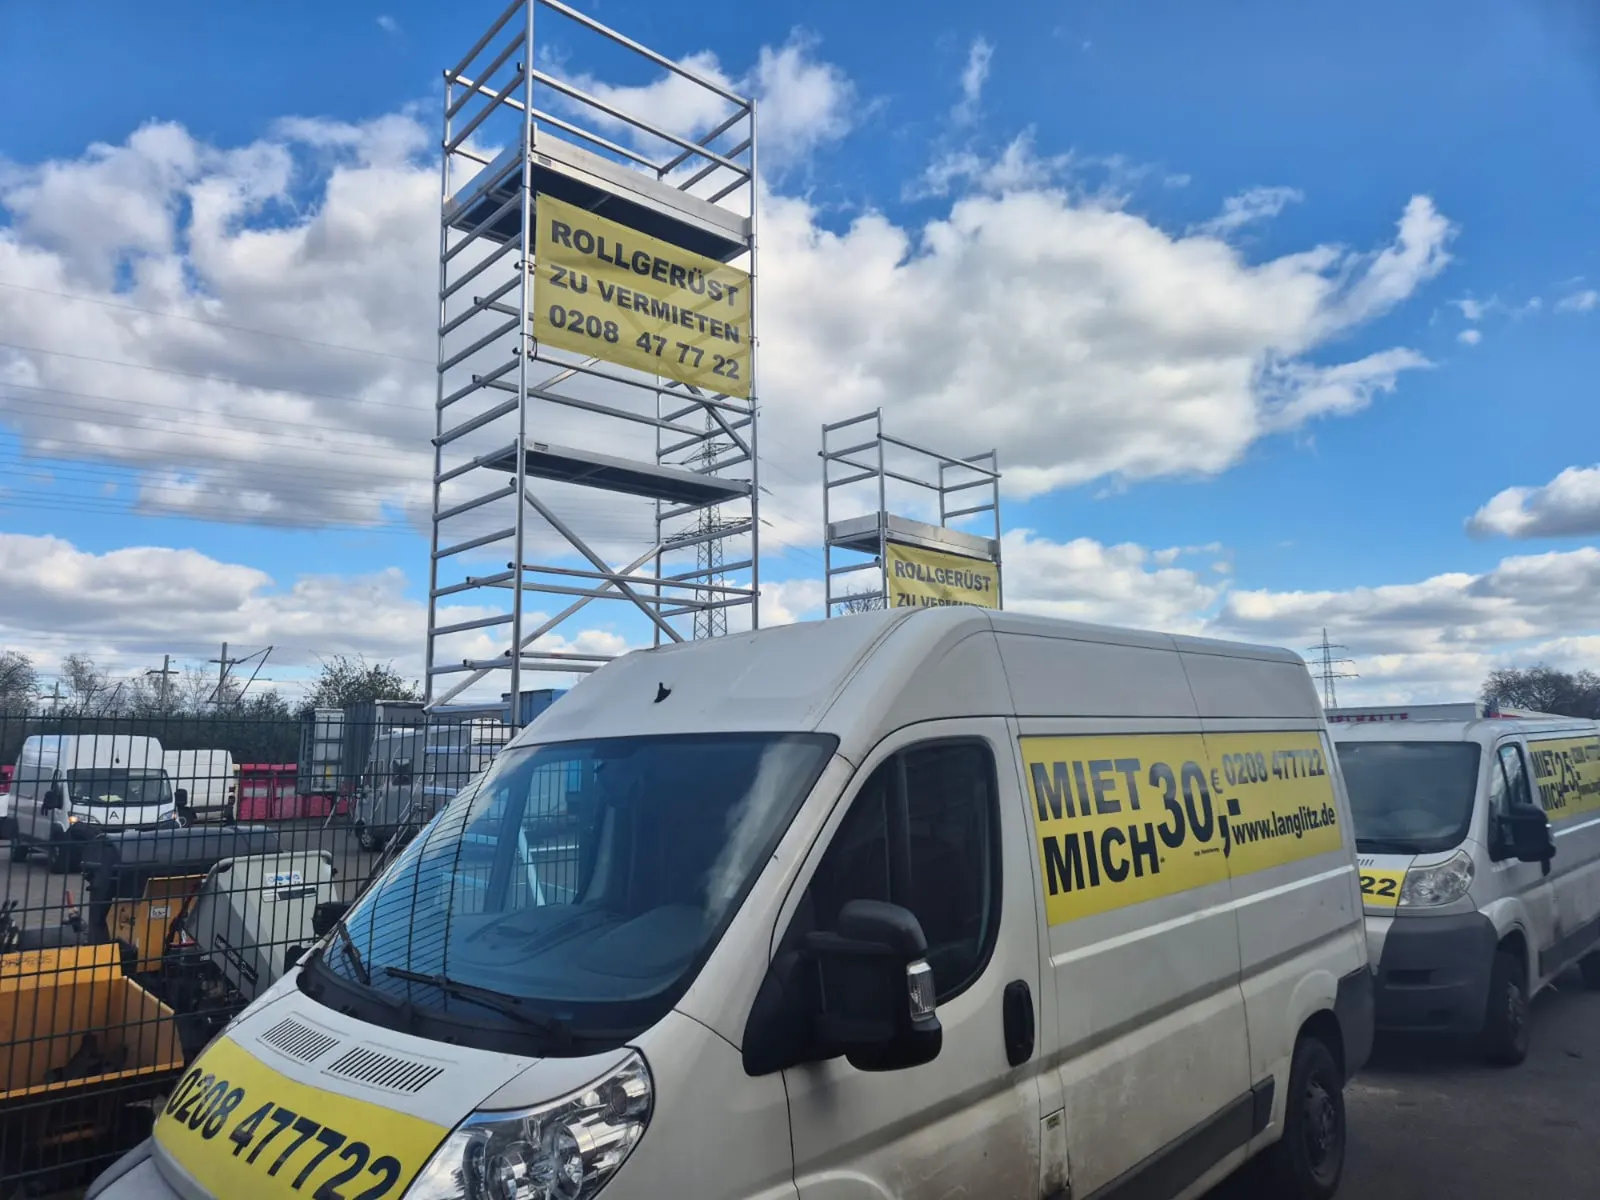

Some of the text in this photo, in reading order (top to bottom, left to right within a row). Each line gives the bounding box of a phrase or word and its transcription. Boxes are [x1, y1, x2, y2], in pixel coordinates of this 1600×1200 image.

[551, 219, 738, 306] ROLLGERÜST
[549, 265, 740, 344] ZU VERMIETEN
[549, 304, 740, 380] 0208 47 77 22
[894, 560, 991, 592] ROLLGERÜST
[1030, 758, 1141, 822] MIET
[1222, 748, 1325, 786] 0208 477722
[1232, 802, 1336, 846] www.langlitz.de
[166, 1068, 402, 1199] 0208 477722
